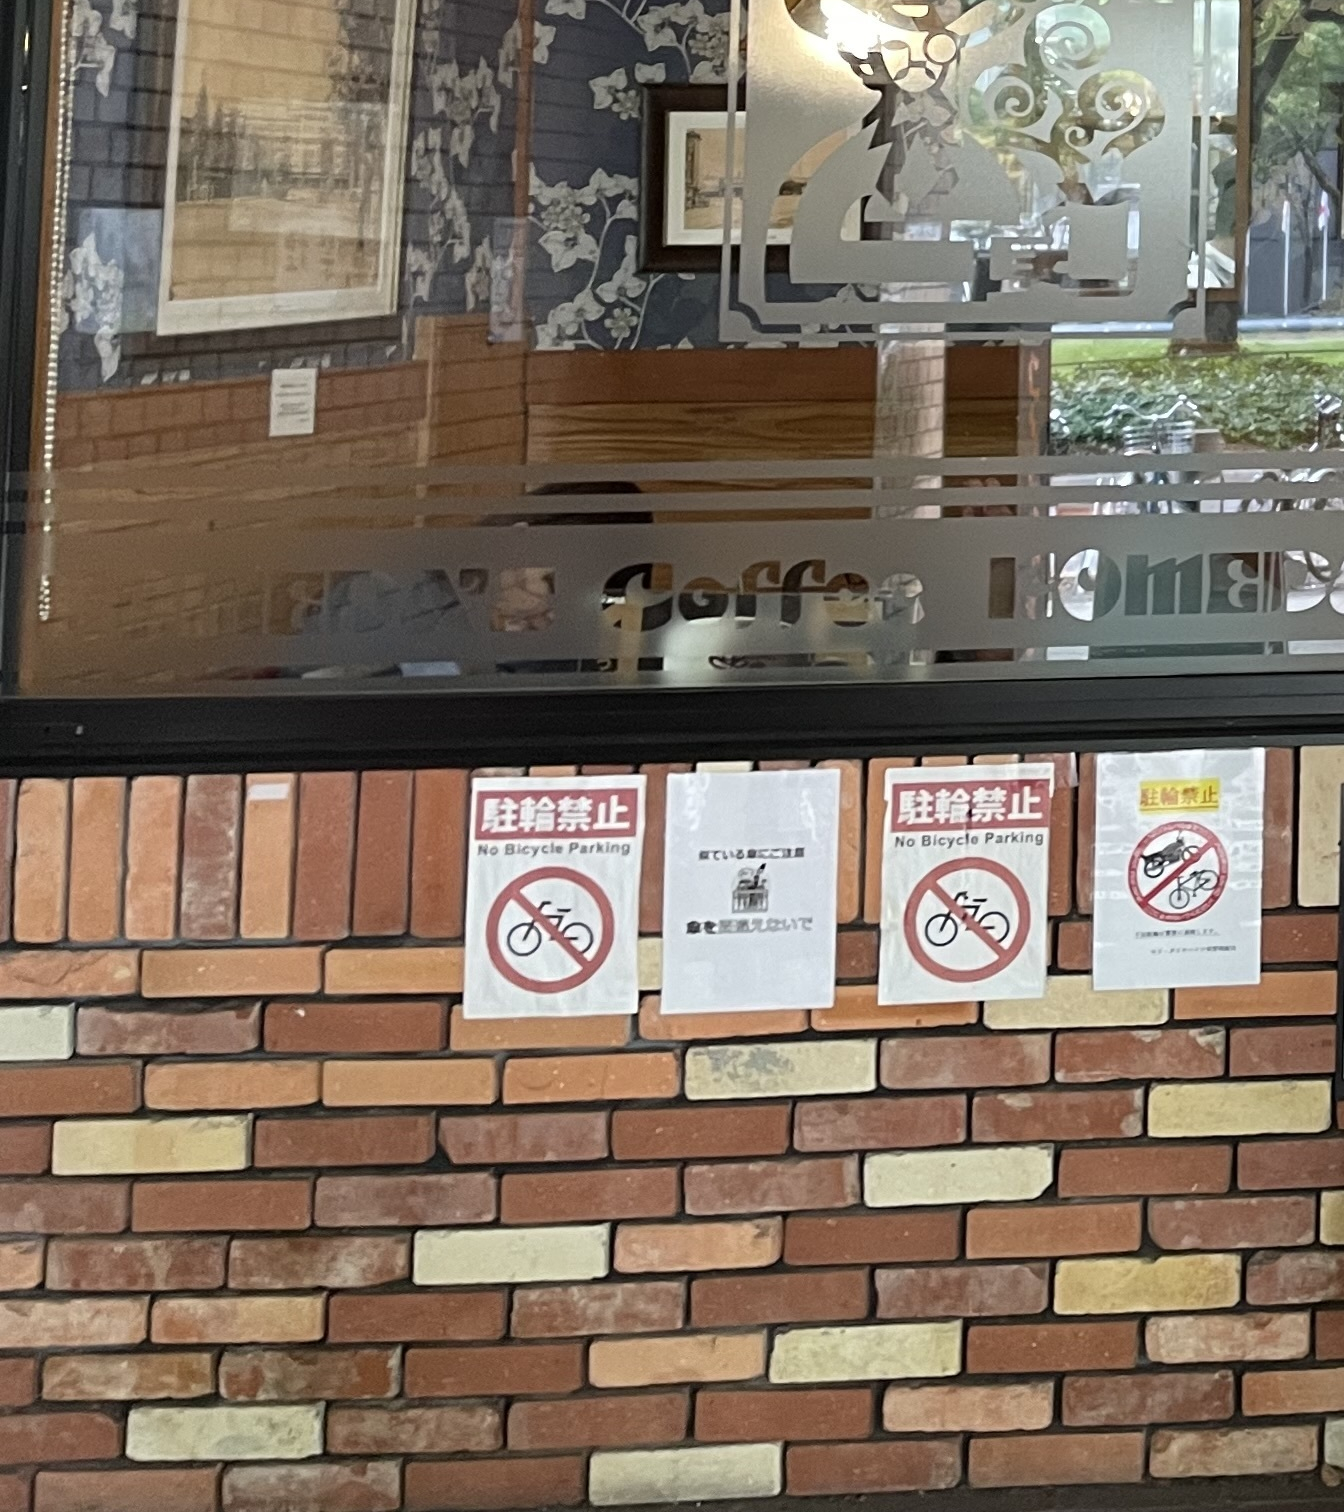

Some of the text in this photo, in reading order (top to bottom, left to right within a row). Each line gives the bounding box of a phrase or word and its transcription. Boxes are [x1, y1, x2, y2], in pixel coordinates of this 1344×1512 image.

[897, 785, 1044, 826] 駐輪禁止
[1140, 784, 1219, 807] 駐輪禁止
[481, 794, 631, 834] 駐輪禁止
[477, 841, 631, 858] No Bicycle Parking
[894, 831, 1045, 849] No Bicycle Parking
